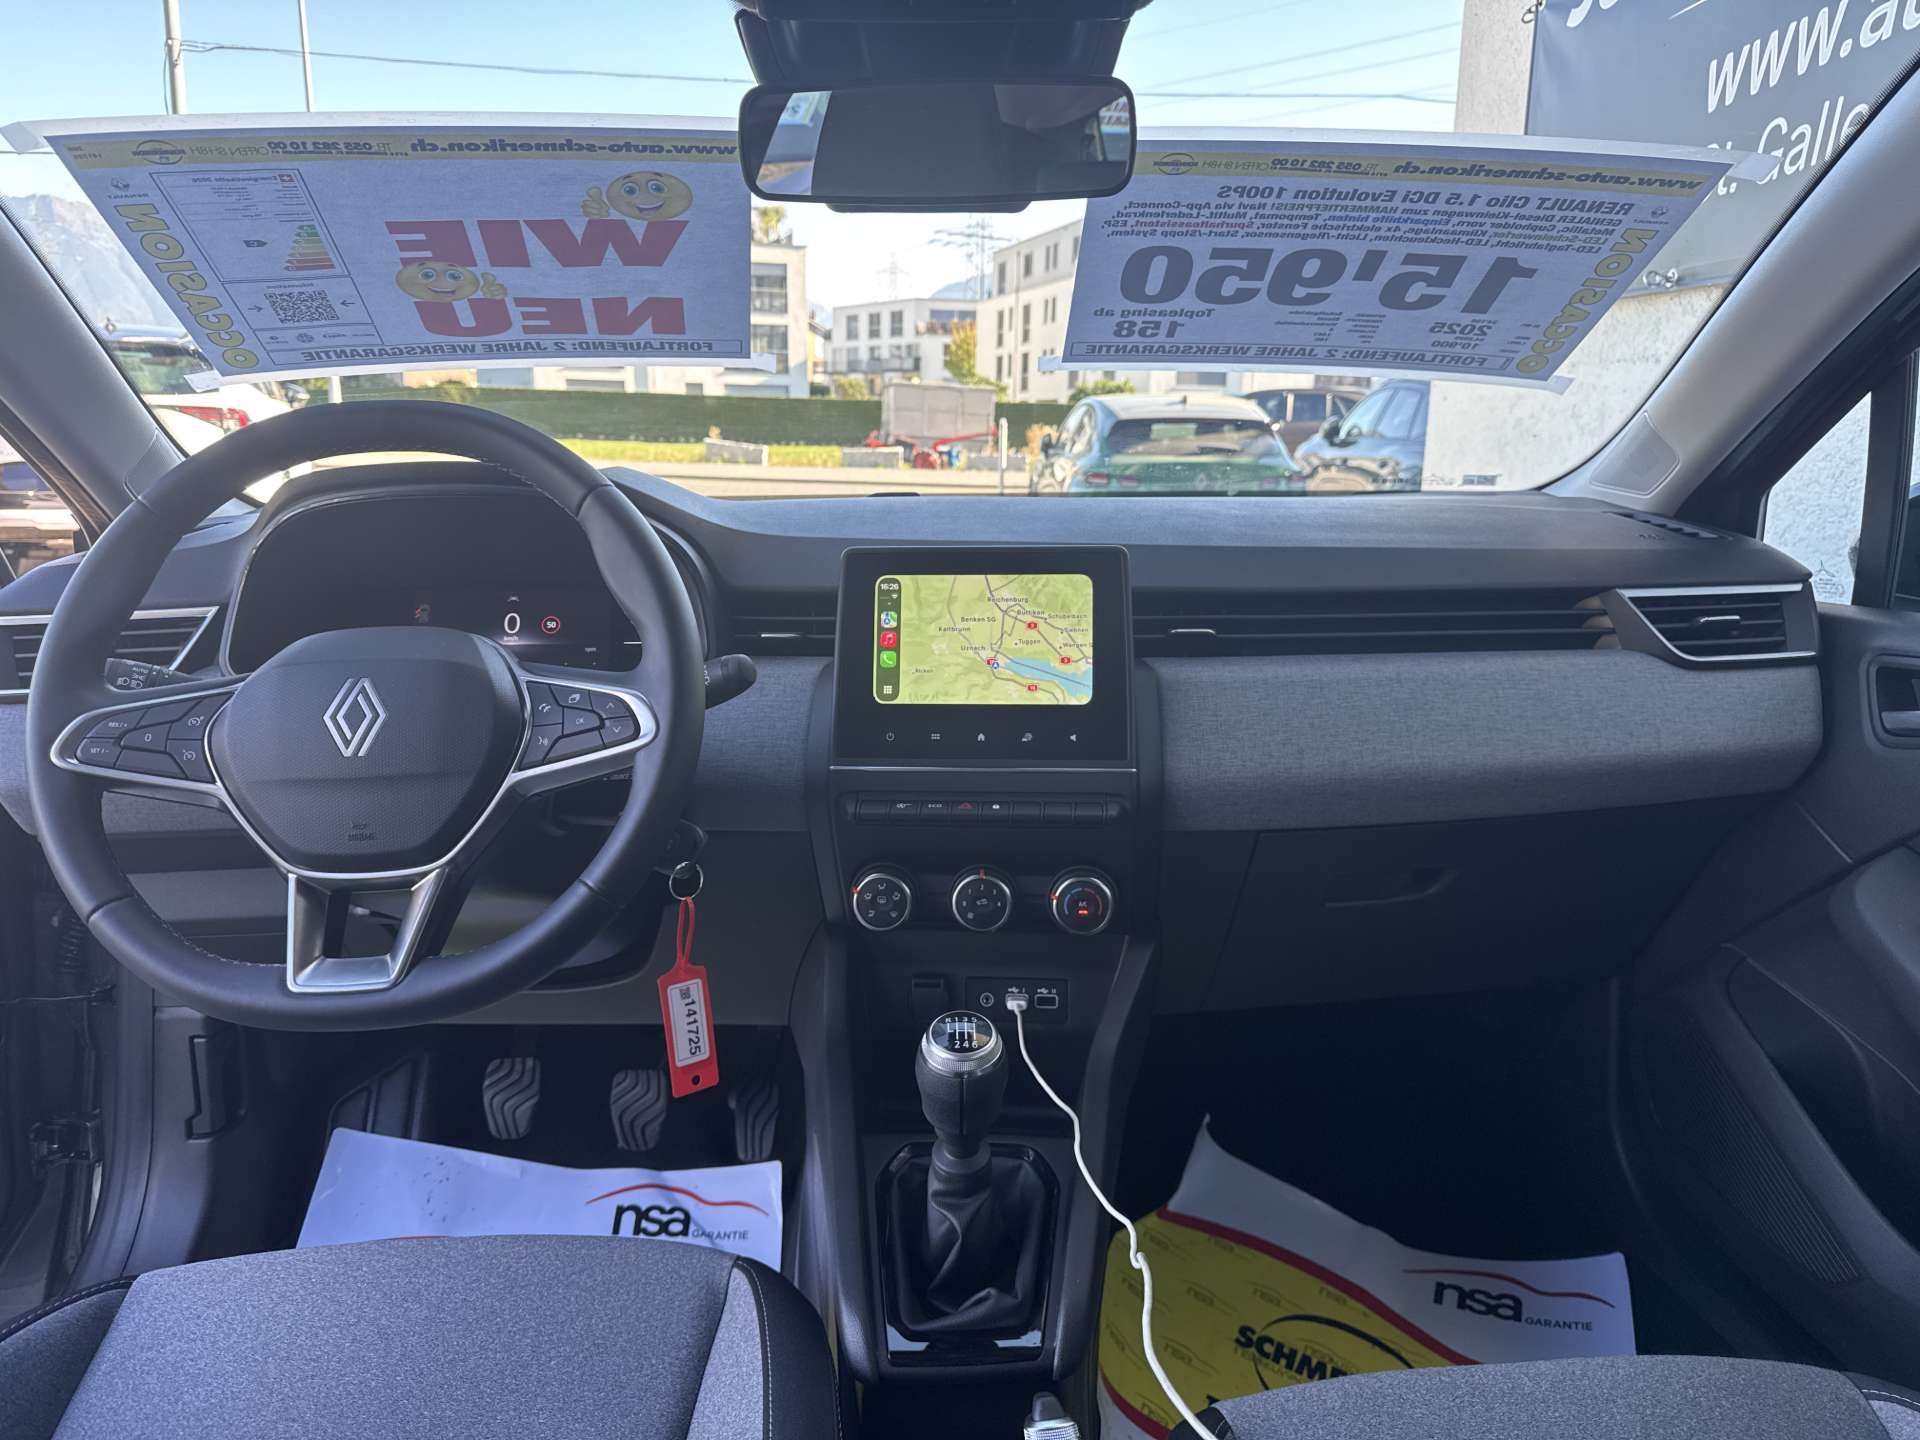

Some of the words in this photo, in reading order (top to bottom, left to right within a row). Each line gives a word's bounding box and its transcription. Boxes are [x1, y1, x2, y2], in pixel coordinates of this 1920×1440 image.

[504, 612, 521, 633] 0
[546, 621, 557, 629] 50
[685, 998, 702, 1056] 141725
[962, 1040, 970, 1049] 4
[611, 1204, 691, 1237] nsa
[691, 1229, 750, 1241] GARANTIE
[1433, 1281, 1523, 1323] nsa
[1524, 1316, 1593, 1332] GARANTIE
